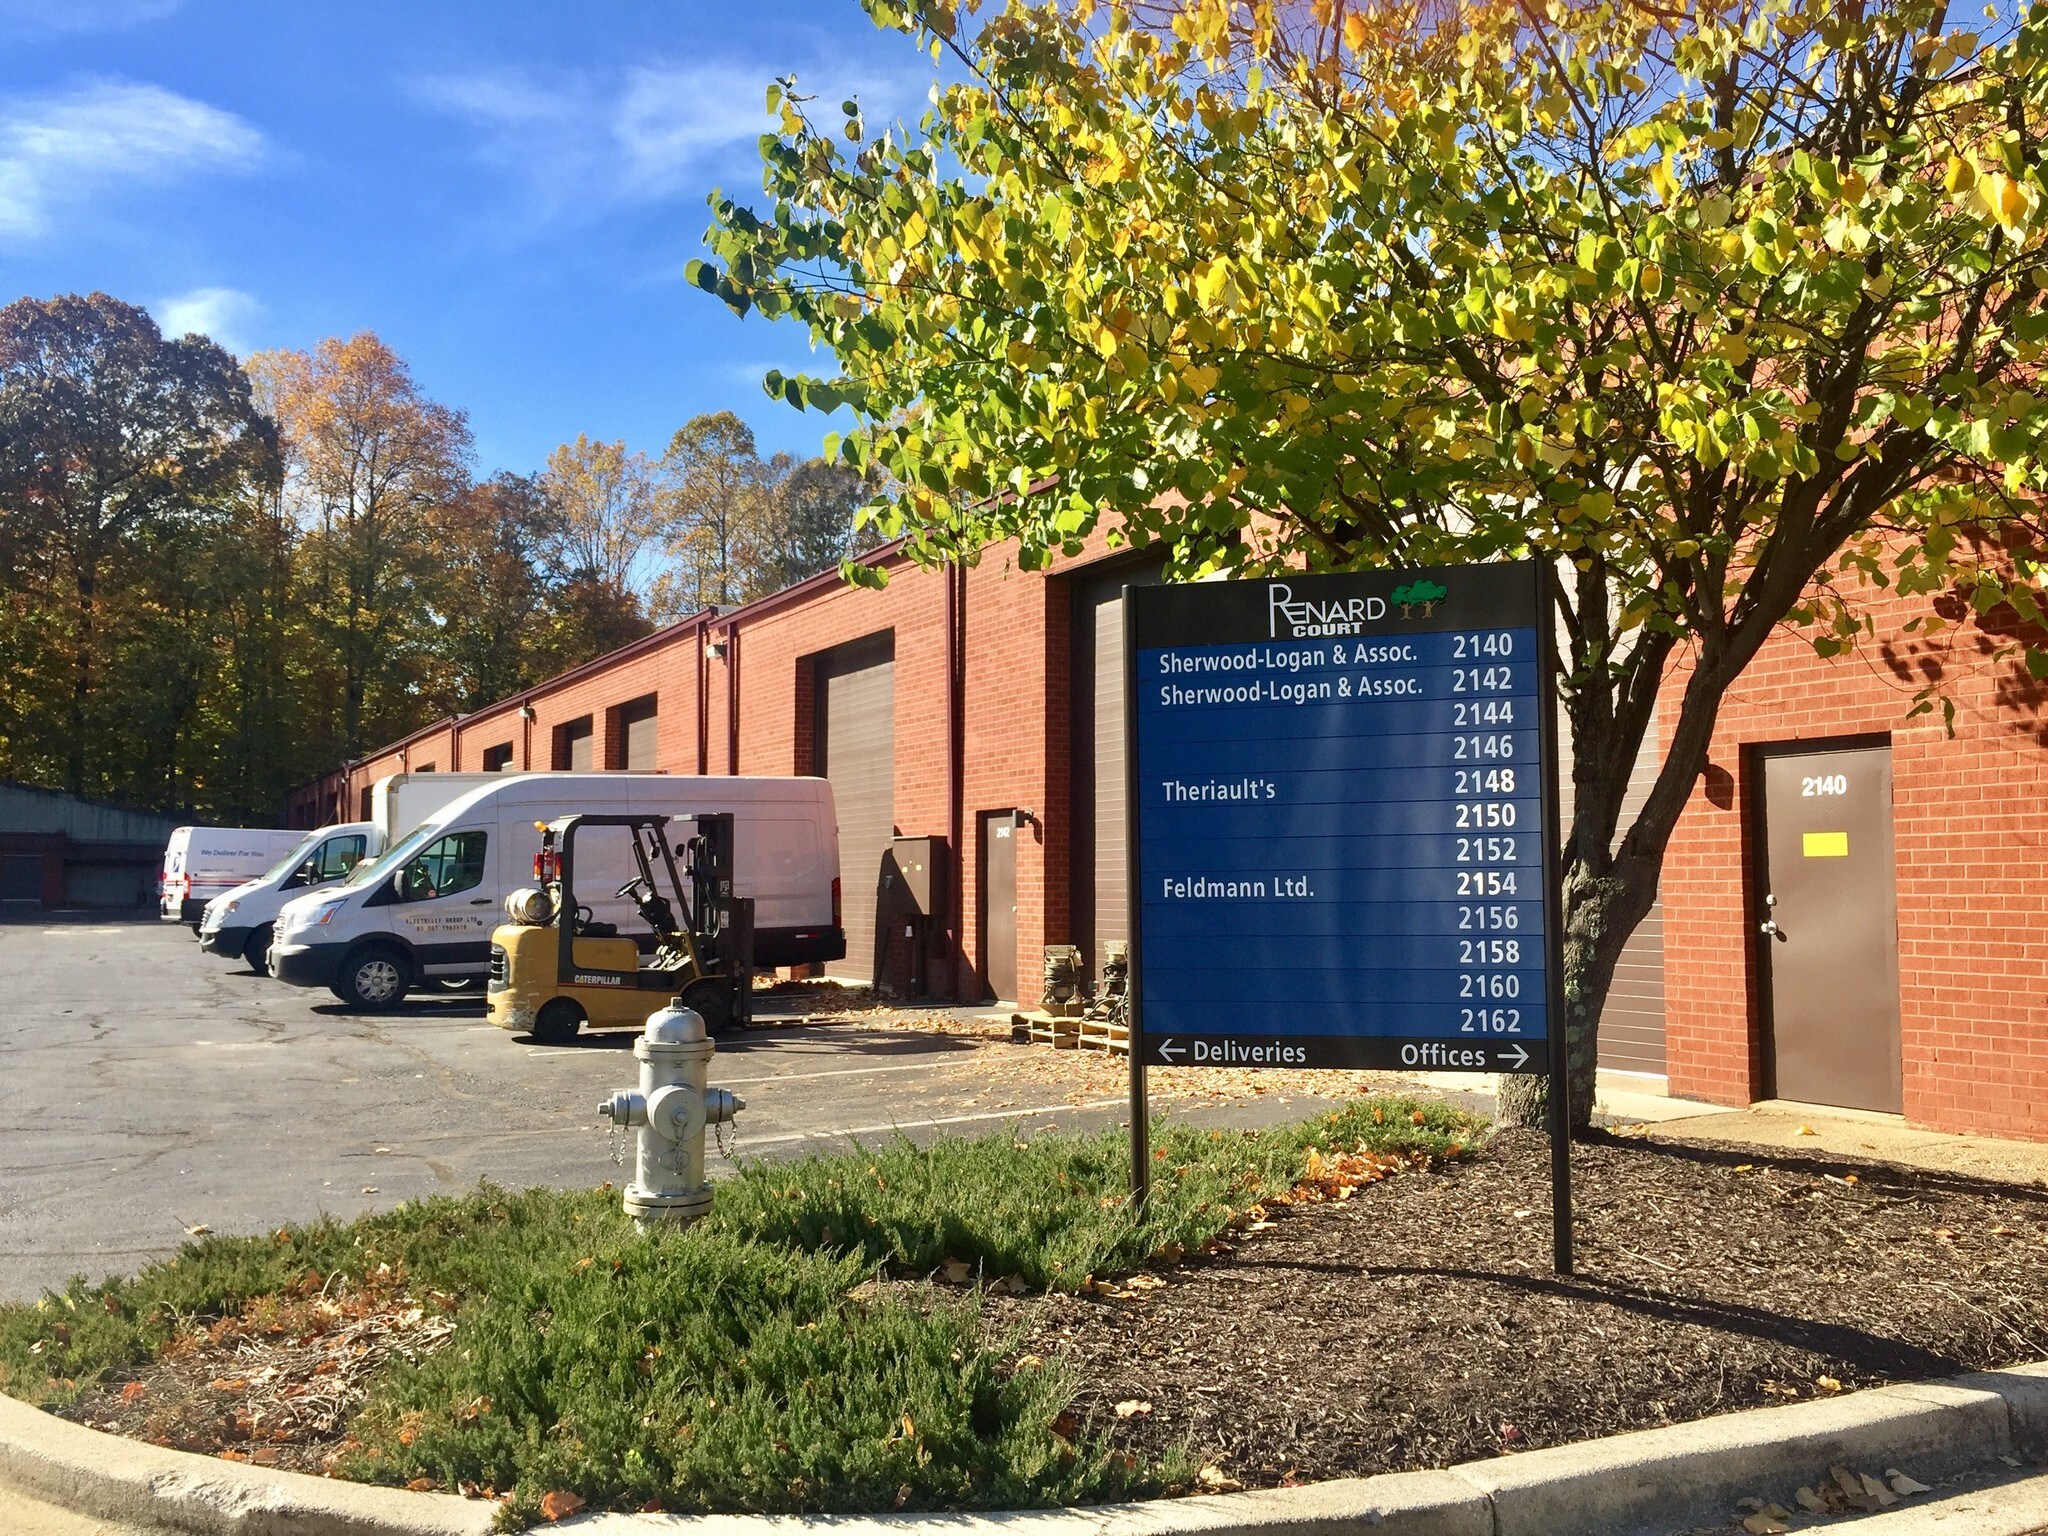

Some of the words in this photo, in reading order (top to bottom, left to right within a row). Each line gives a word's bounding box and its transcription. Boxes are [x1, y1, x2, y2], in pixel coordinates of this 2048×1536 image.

[1268, 583, 1386, 637] RENARD
[1292, 622, 1363, 637] COURT
[1453, 633, 1513, 659] 2140
[1160, 648, 1325, 674] Sherwood-Logan
[1332, 644, 1347, 665] &
[1353, 643, 1417, 664] Assoc.
[1160, 680, 1331, 706] Sherwood-Logan
[1337, 676, 1352, 698] &
[1357, 676, 1423, 697] Assoc.
[1452, 667, 1512, 692] 2142
[1453, 701, 1514, 726] 2144
[1454, 735, 1514, 760] 2146
[1162, 778, 1276, 802] Theriault's
[1454, 769, 1515, 794] 2148
[1801, 774, 1847, 797] 2140
[1455, 803, 1517, 828] 2150
[213, 849, 238, 857] Deliver
[1456, 838, 1517, 862] 2152
[1163, 877, 1265, 898] Feldmann
[1274, 875, 1315, 897] Ltd.
[1457, 872, 1517, 896] 2154
[1458, 906, 1519, 930] 2156
[1459, 940, 1520, 964] 2158
[574, 974, 621, 985] CATERPILLAR
[1460, 974, 1520, 998] 2160
[1461, 1008, 1521, 1033] 2162
[1194, 1040, 1306, 1063] Deliveries
[1401, 1043, 1486, 1067] Offices
